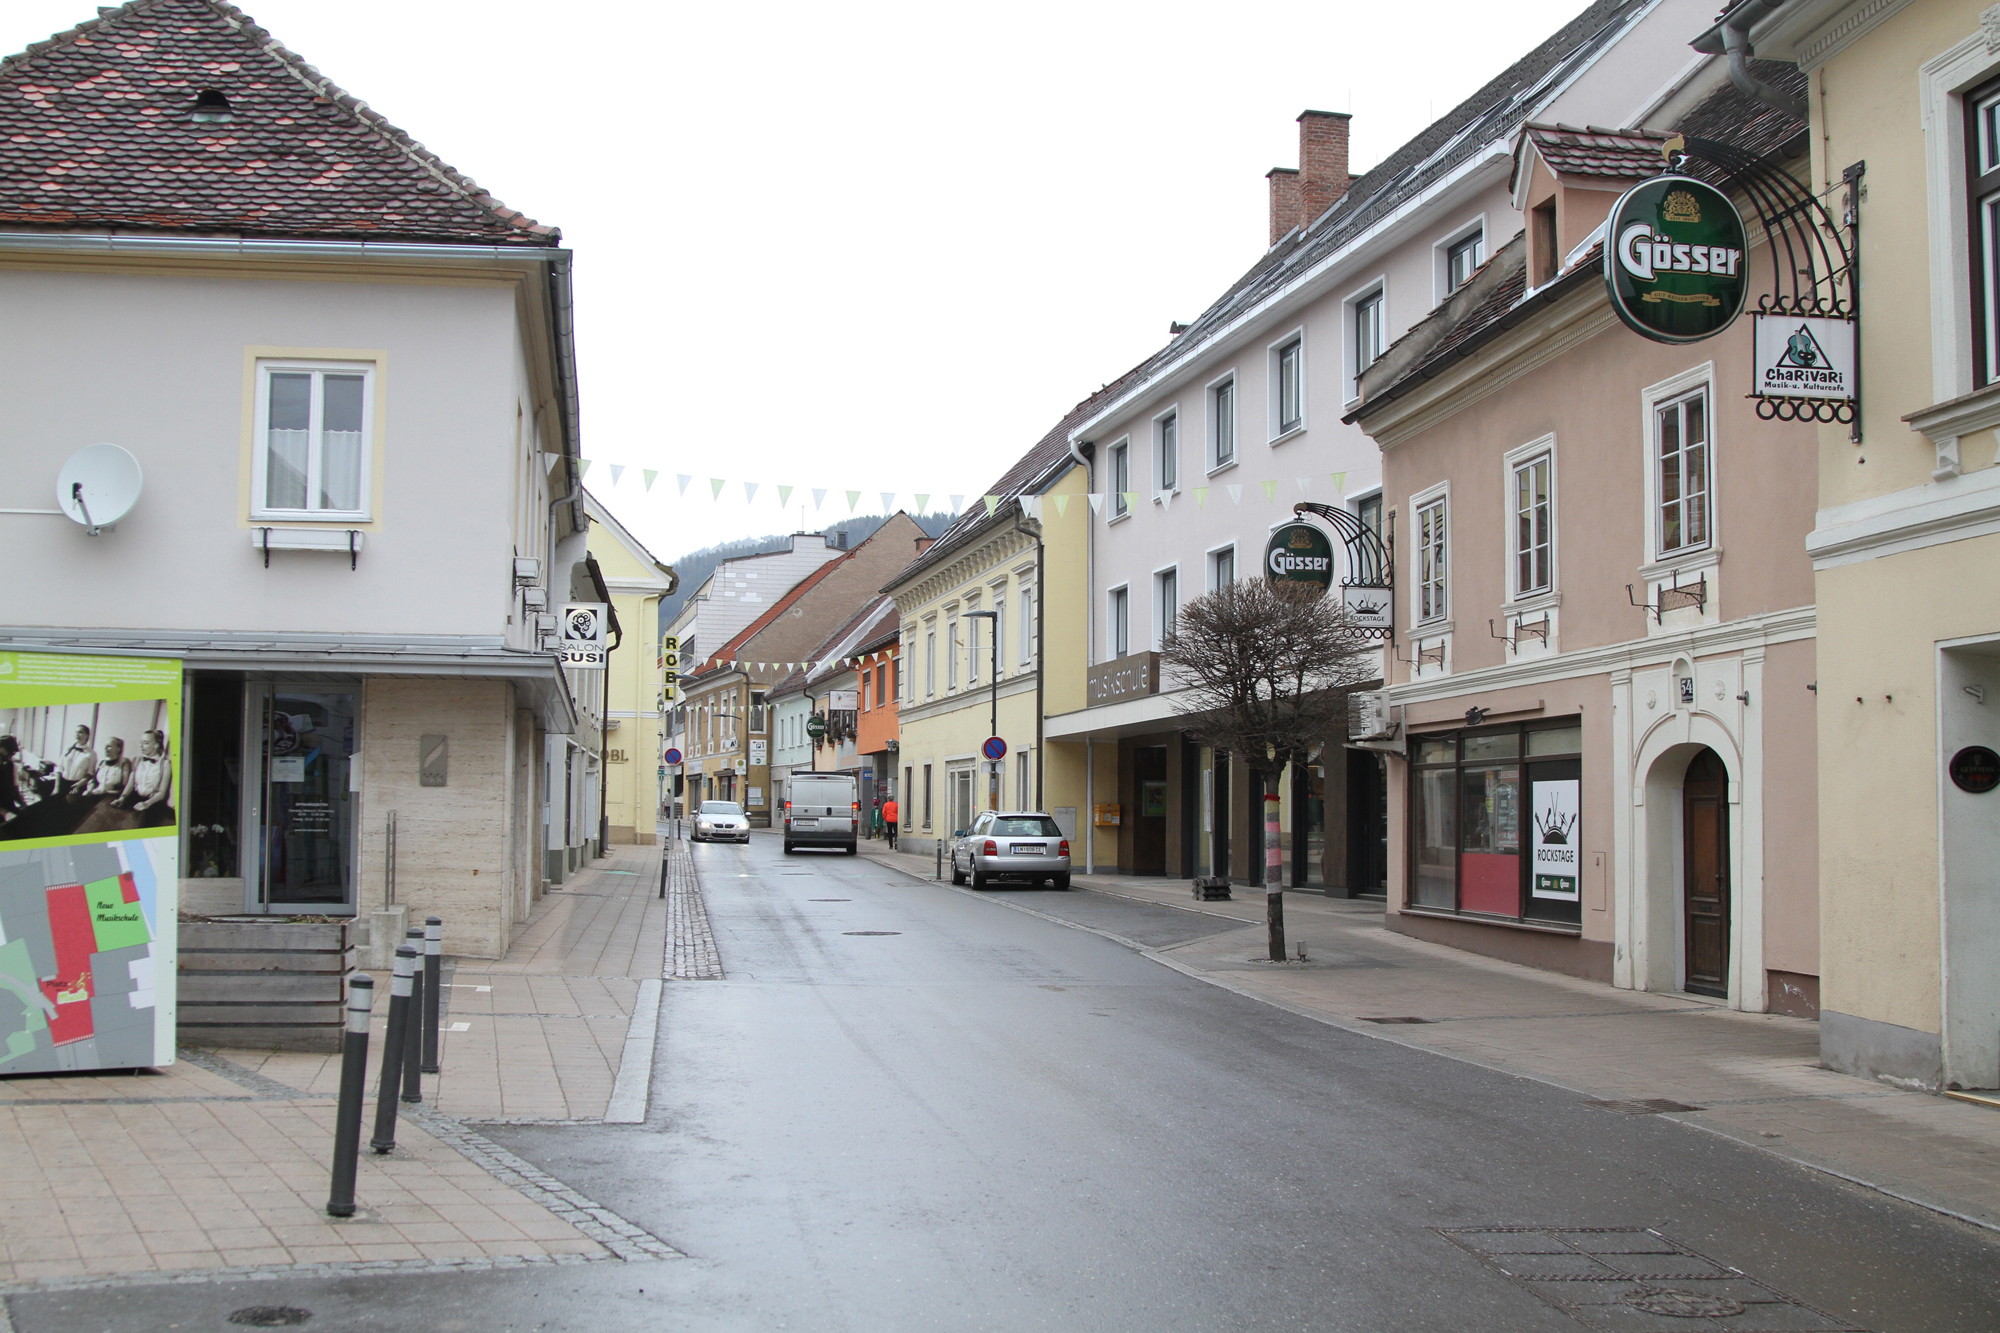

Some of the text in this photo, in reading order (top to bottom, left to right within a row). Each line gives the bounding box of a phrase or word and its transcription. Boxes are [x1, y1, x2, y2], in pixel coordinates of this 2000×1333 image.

[1617, 224, 1741, 281] Gösser
[1765, 368, 1843, 384] ChaRiVaRi
[1803, 383, 1845, 391] Kulturcafe
[1269, 547, 1329, 575] Gösser
[558, 643, 604, 651] SALON
[560, 652, 604, 663] SUSI
[1088, 659, 1148, 699] musikschule
[1681, 679, 1693, 694] 54
[1537, 848, 1574, 863] ROCKSTAGE
[96, 901, 114, 909] Neue
[96, 913, 139, 922] Musikschule
